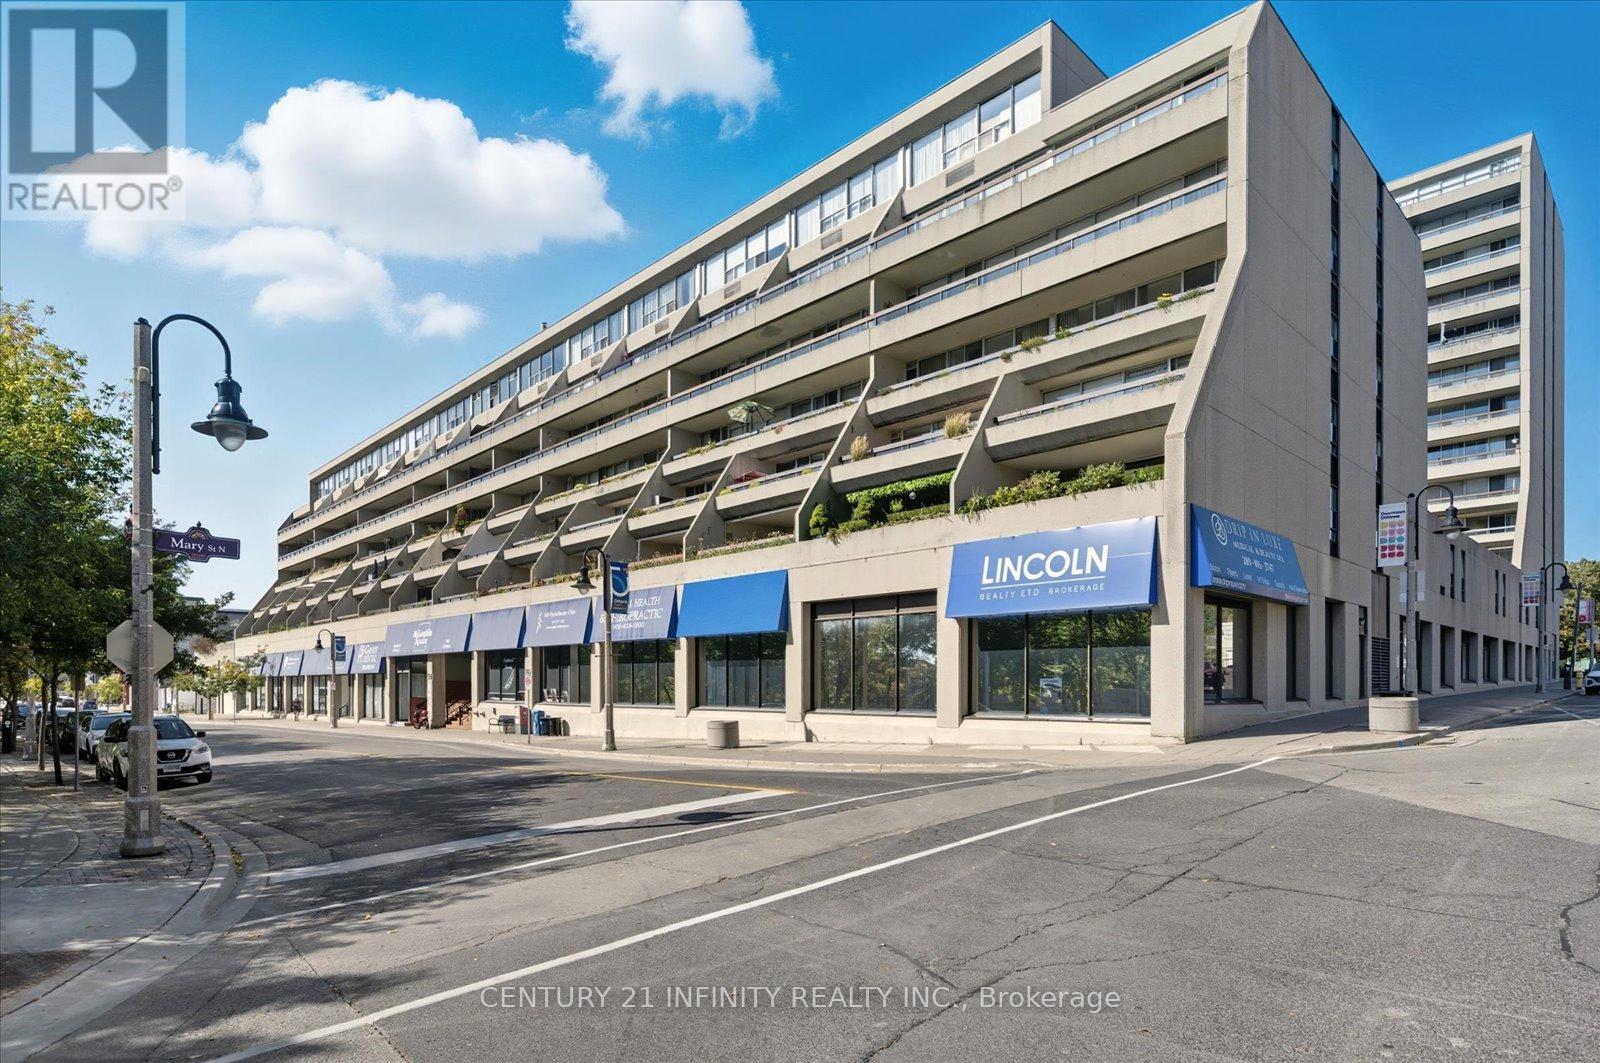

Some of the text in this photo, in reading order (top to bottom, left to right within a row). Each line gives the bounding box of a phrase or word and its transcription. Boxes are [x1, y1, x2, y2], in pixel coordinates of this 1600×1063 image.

[170, 537, 226, 553] Mary St N
[981, 544, 1109, 585] LINCOLN
[1048, 583, 1105, 595] BROKERAGE
[634, 596, 661, 608] HEALTH
[609, 608, 664, 623] HIROPRACTIC
